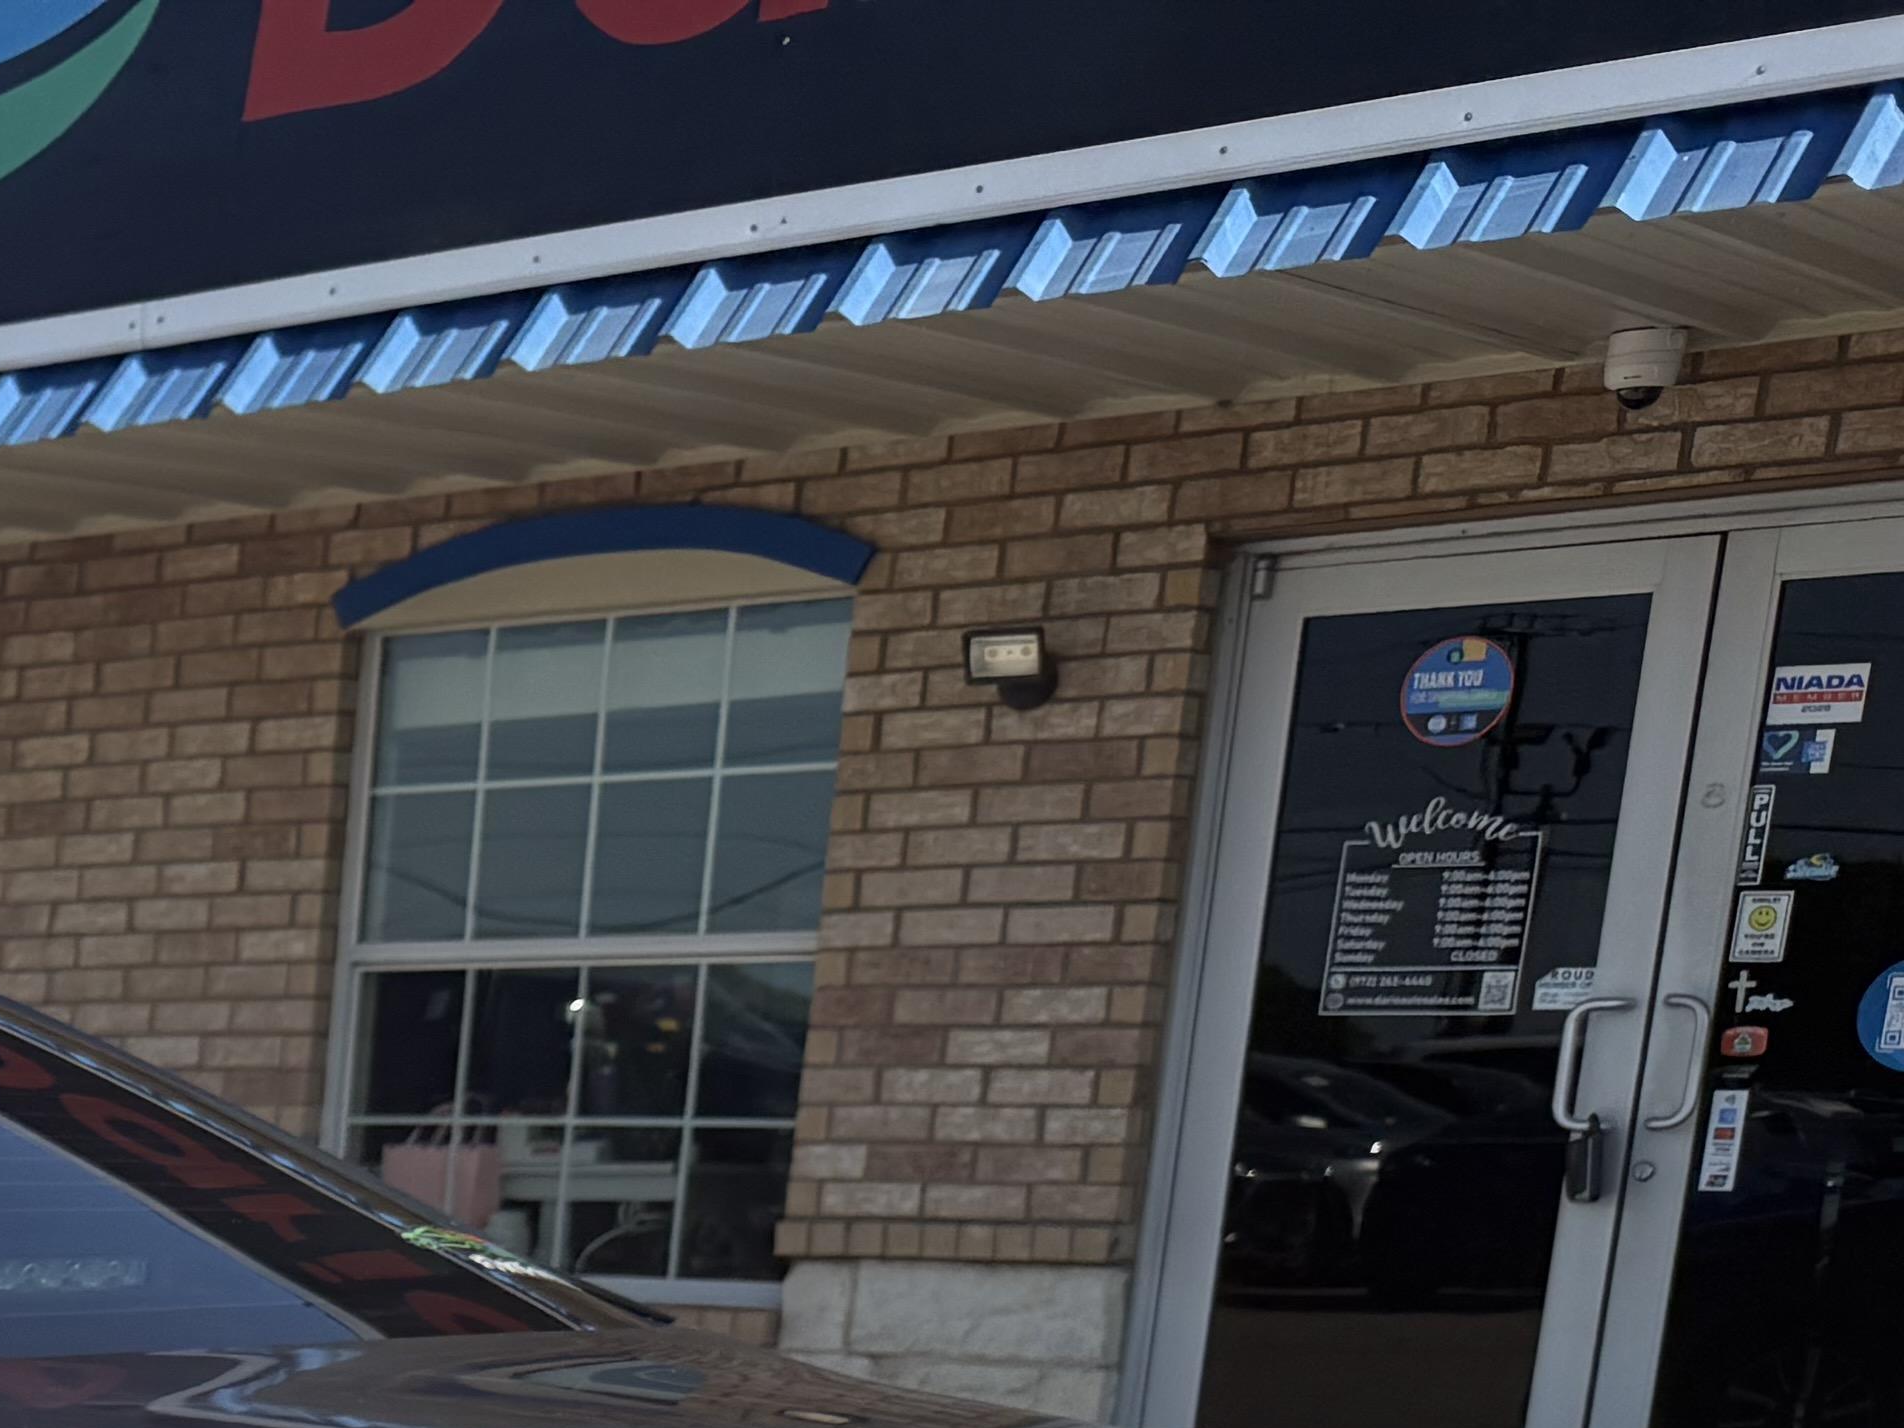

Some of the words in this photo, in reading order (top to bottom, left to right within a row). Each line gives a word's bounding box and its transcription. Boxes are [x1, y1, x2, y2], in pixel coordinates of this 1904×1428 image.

[1413, 670, 1455, 690] THANK
[1458, 668, 1485, 687] YOU
[1775, 674, 1865, 690] NIADA
[1364, 796, 1520, 848] Welcome
[1745, 793, 1770, 861] PULL
[1399, 852, 1434, 865] OPEN
[1437, 851, 1481, 864] HOURS
[1451, 950, 1498, 963] CLOSED
